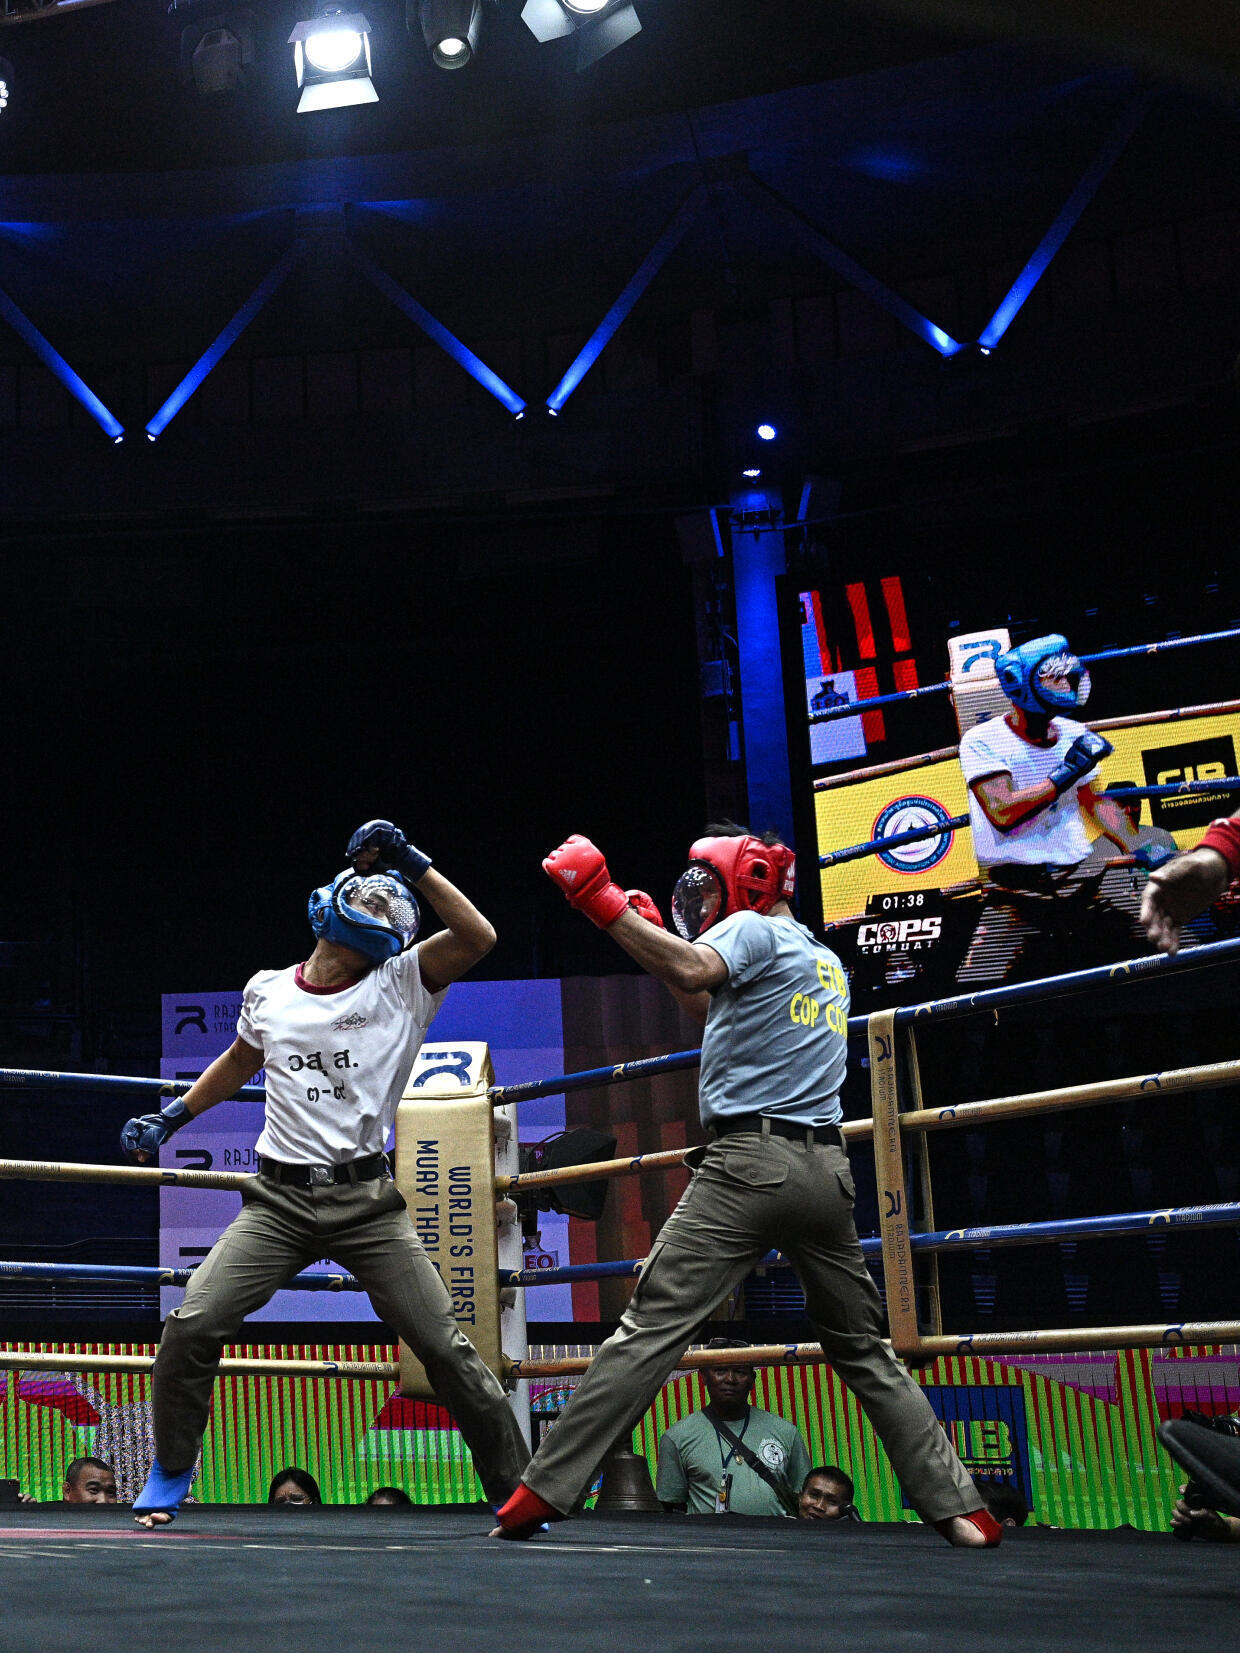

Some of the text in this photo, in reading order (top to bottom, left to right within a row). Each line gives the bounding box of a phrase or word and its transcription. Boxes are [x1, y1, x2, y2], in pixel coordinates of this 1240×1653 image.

[882, 894, 924, 910] 01:38
[857, 917, 942, 945] COPS
[816, 960, 847, 998] CIB
[790, 992, 819, 1027] COP
[416, 1140, 440, 1252] MUAY THAI
[448, 1166, 476, 1326] WORLD'S FIRST
[524, 1254, 555, 1270] EO
[939, 1420, 1013, 1458] IB
